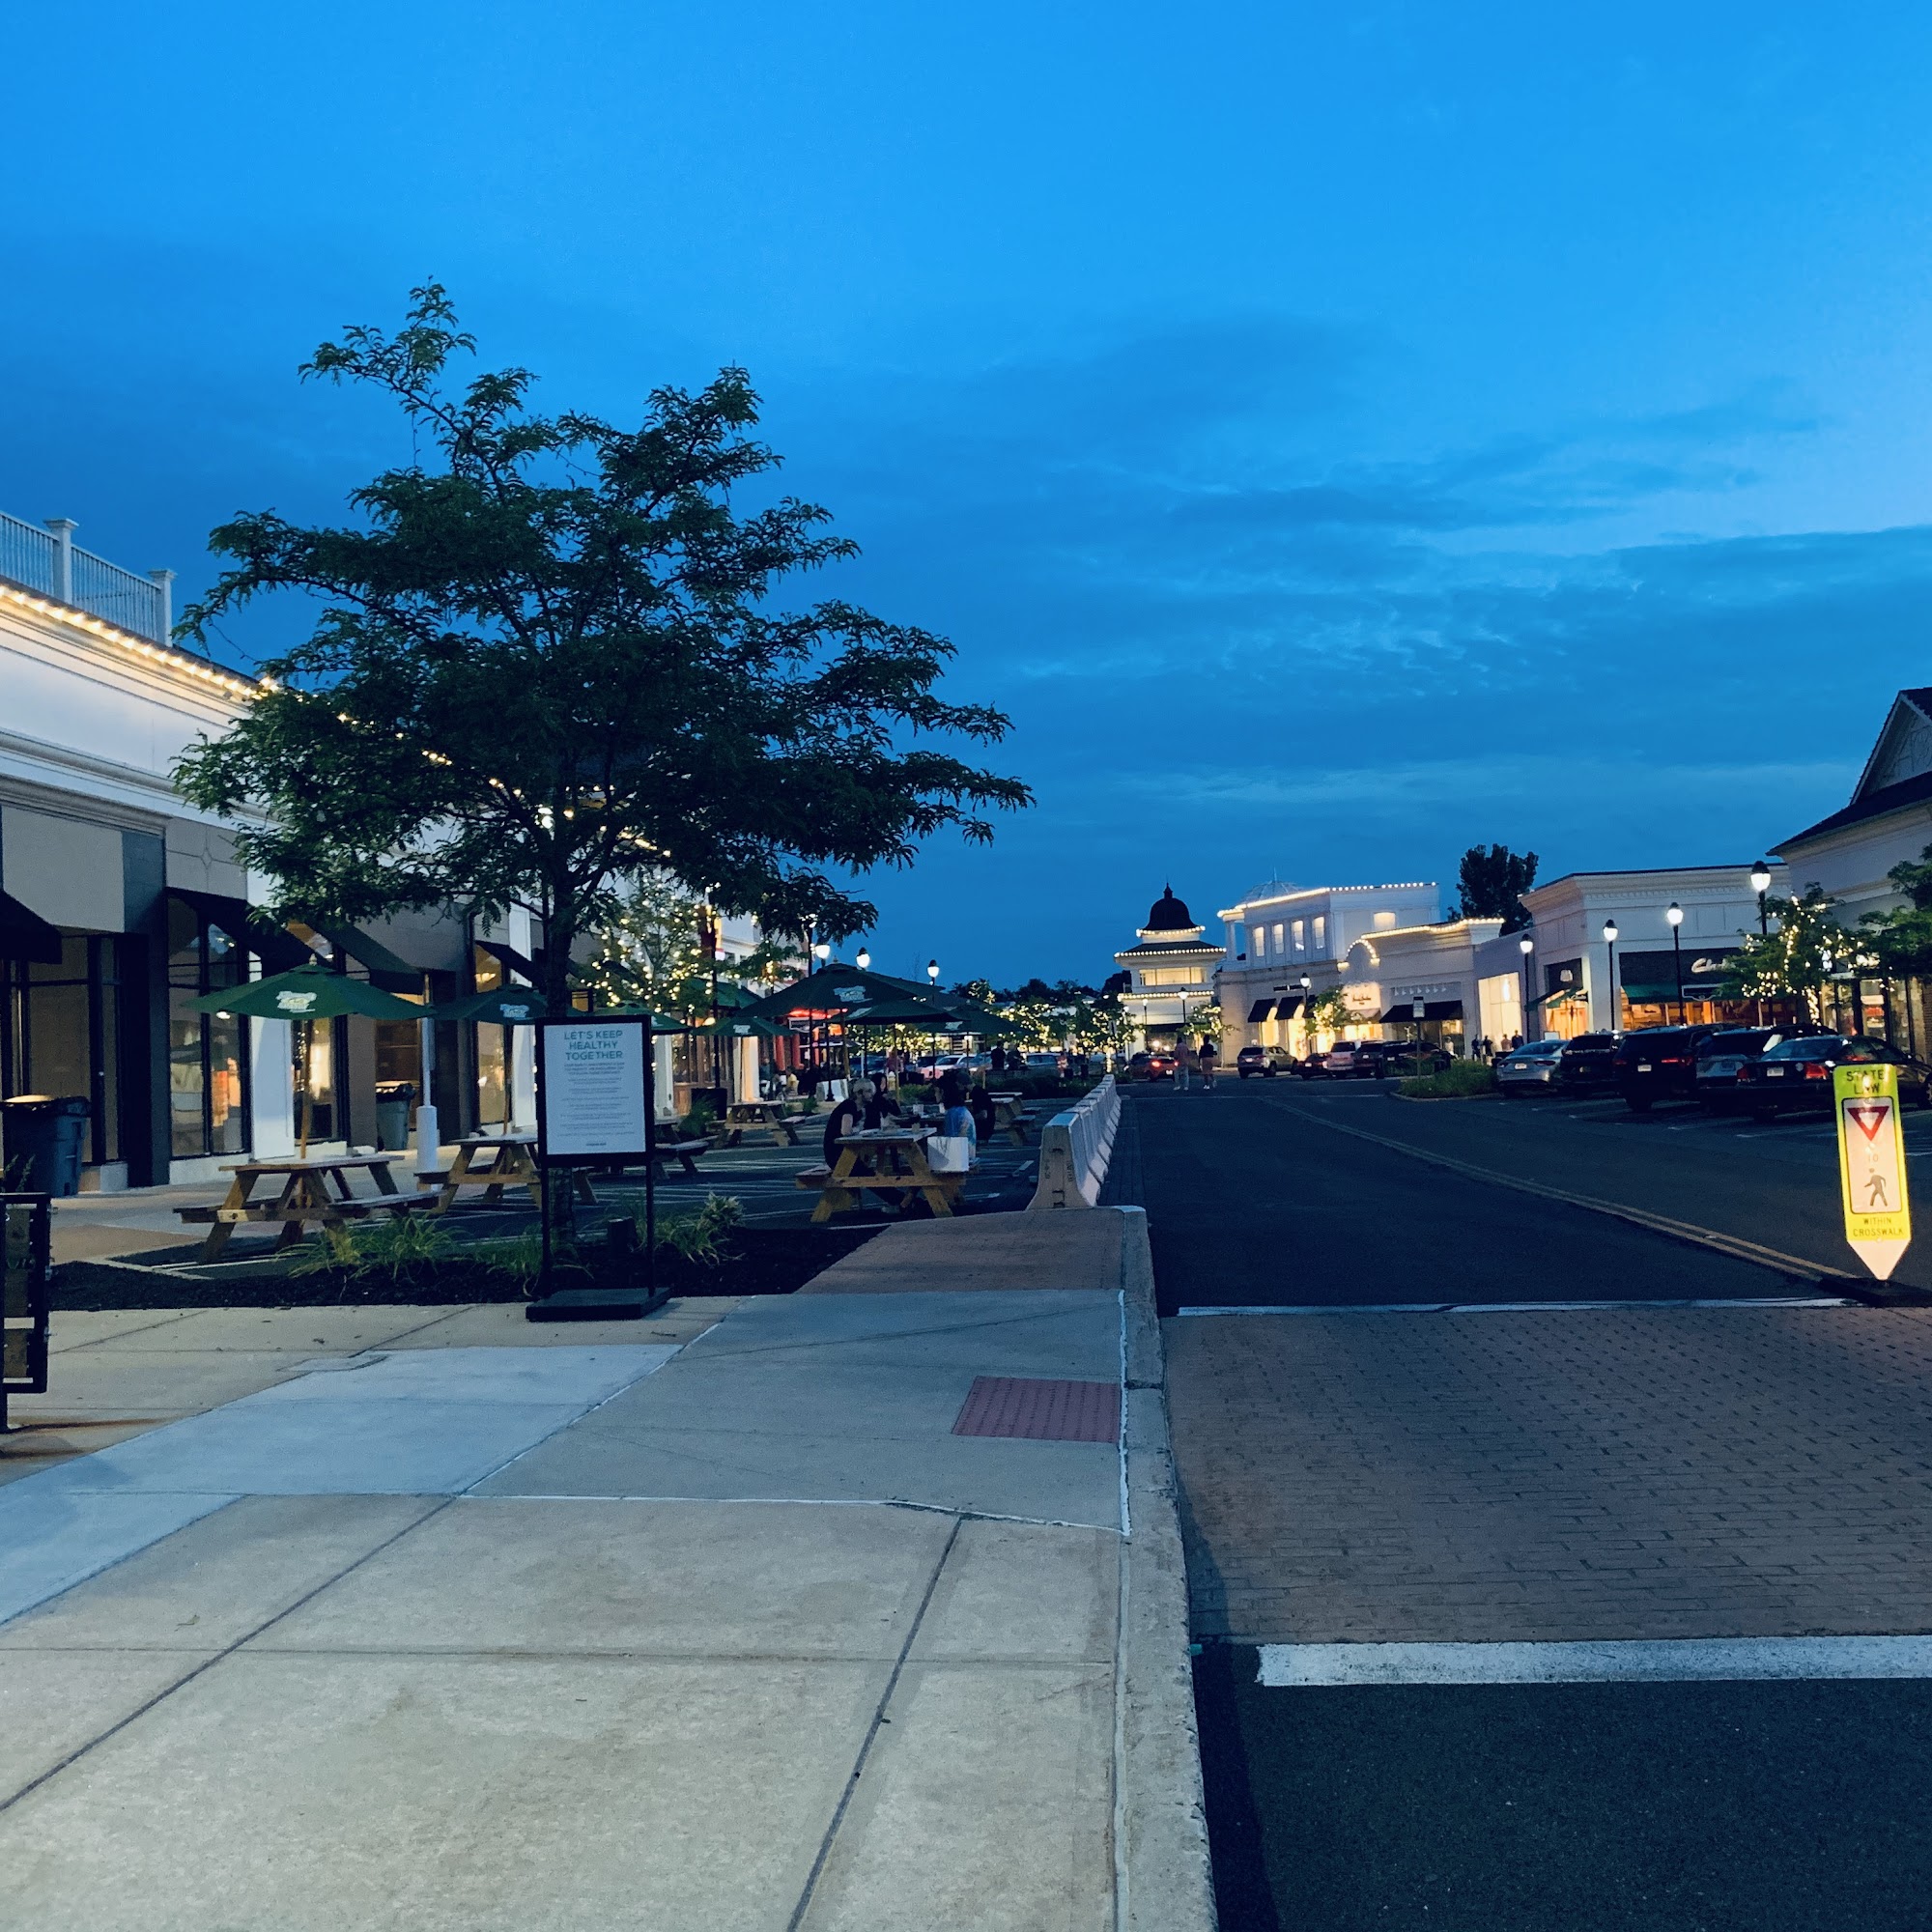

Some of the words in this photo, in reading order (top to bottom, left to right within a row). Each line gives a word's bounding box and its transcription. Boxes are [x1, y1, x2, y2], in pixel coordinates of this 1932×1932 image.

[563, 1031, 594, 1040] LET'S
[595, 1030, 624, 1039] KEEP
[569, 1040, 618, 1050] HEALTHY
[565, 1050, 623, 1061] TOGETHER
[1854, 1082, 1881, 1094] LW
[1862, 1216, 1892, 1226] WITHIN
[1852, 1227, 1905, 1237] CROSSWALK
